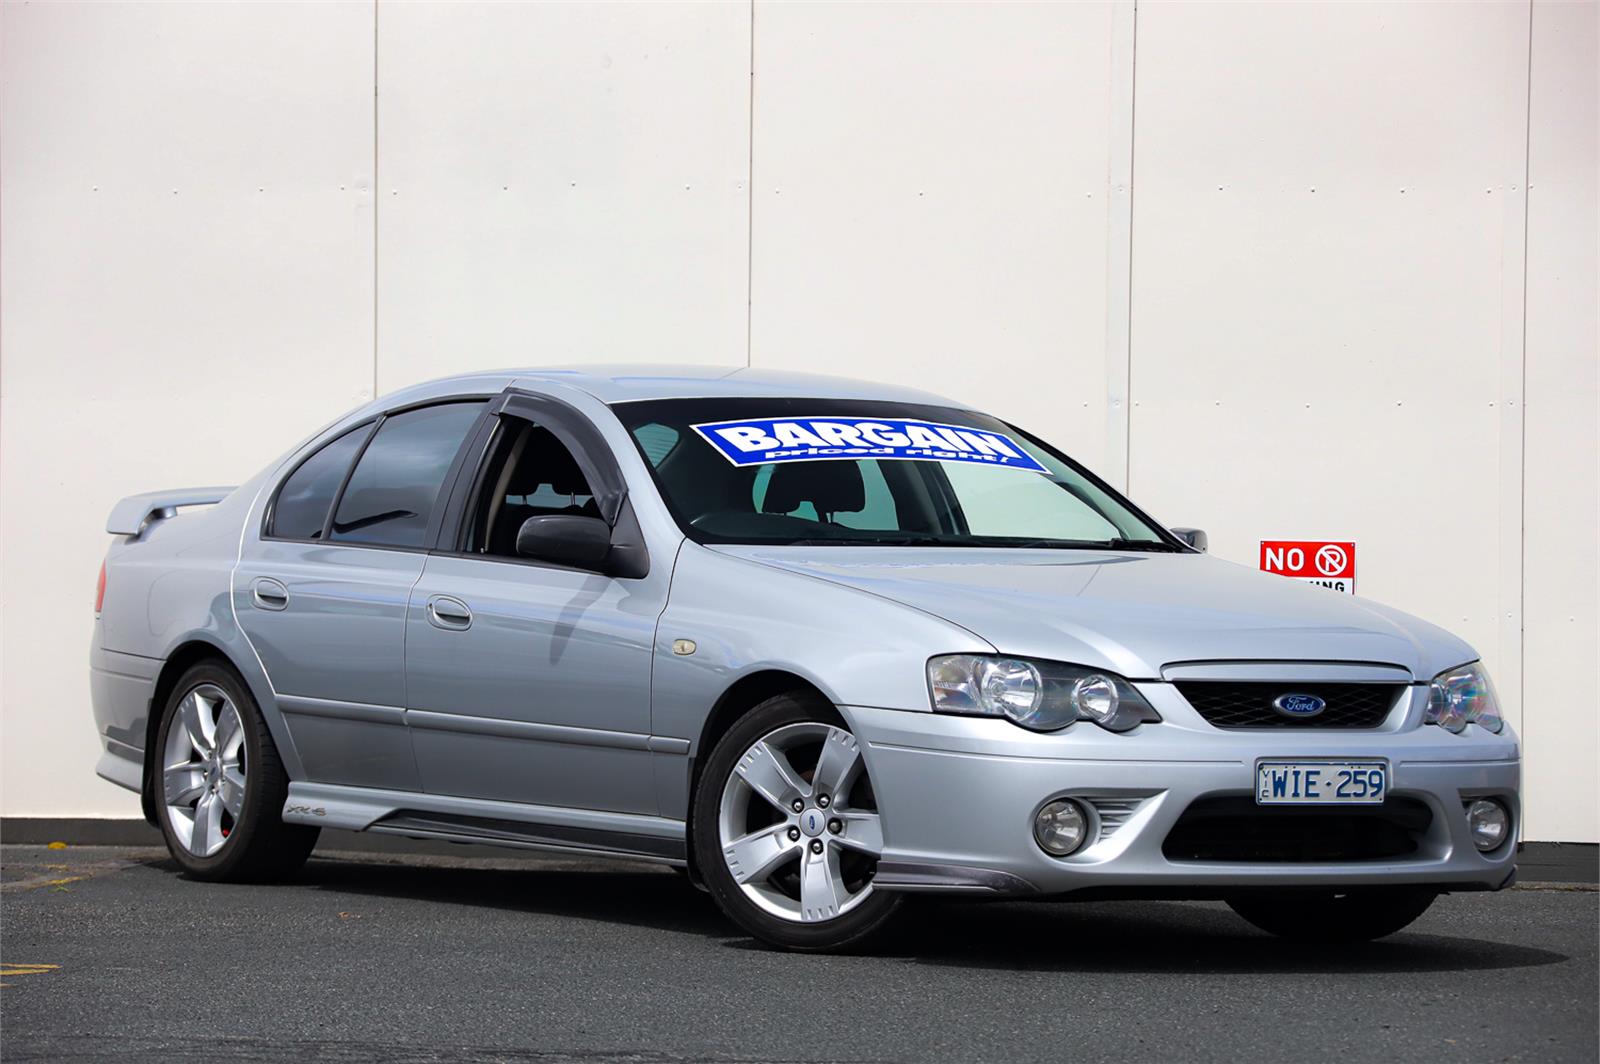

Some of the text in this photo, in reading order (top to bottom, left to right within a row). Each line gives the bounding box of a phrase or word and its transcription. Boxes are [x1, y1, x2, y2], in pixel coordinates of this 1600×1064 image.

[713, 422, 1022, 459] BARGAIN
[765, 447, 894, 459] priced
[1265, 547, 1304, 571] NO
[1286, 696, 1316, 711] Ford
[1261, 770, 1270, 798] VIC
